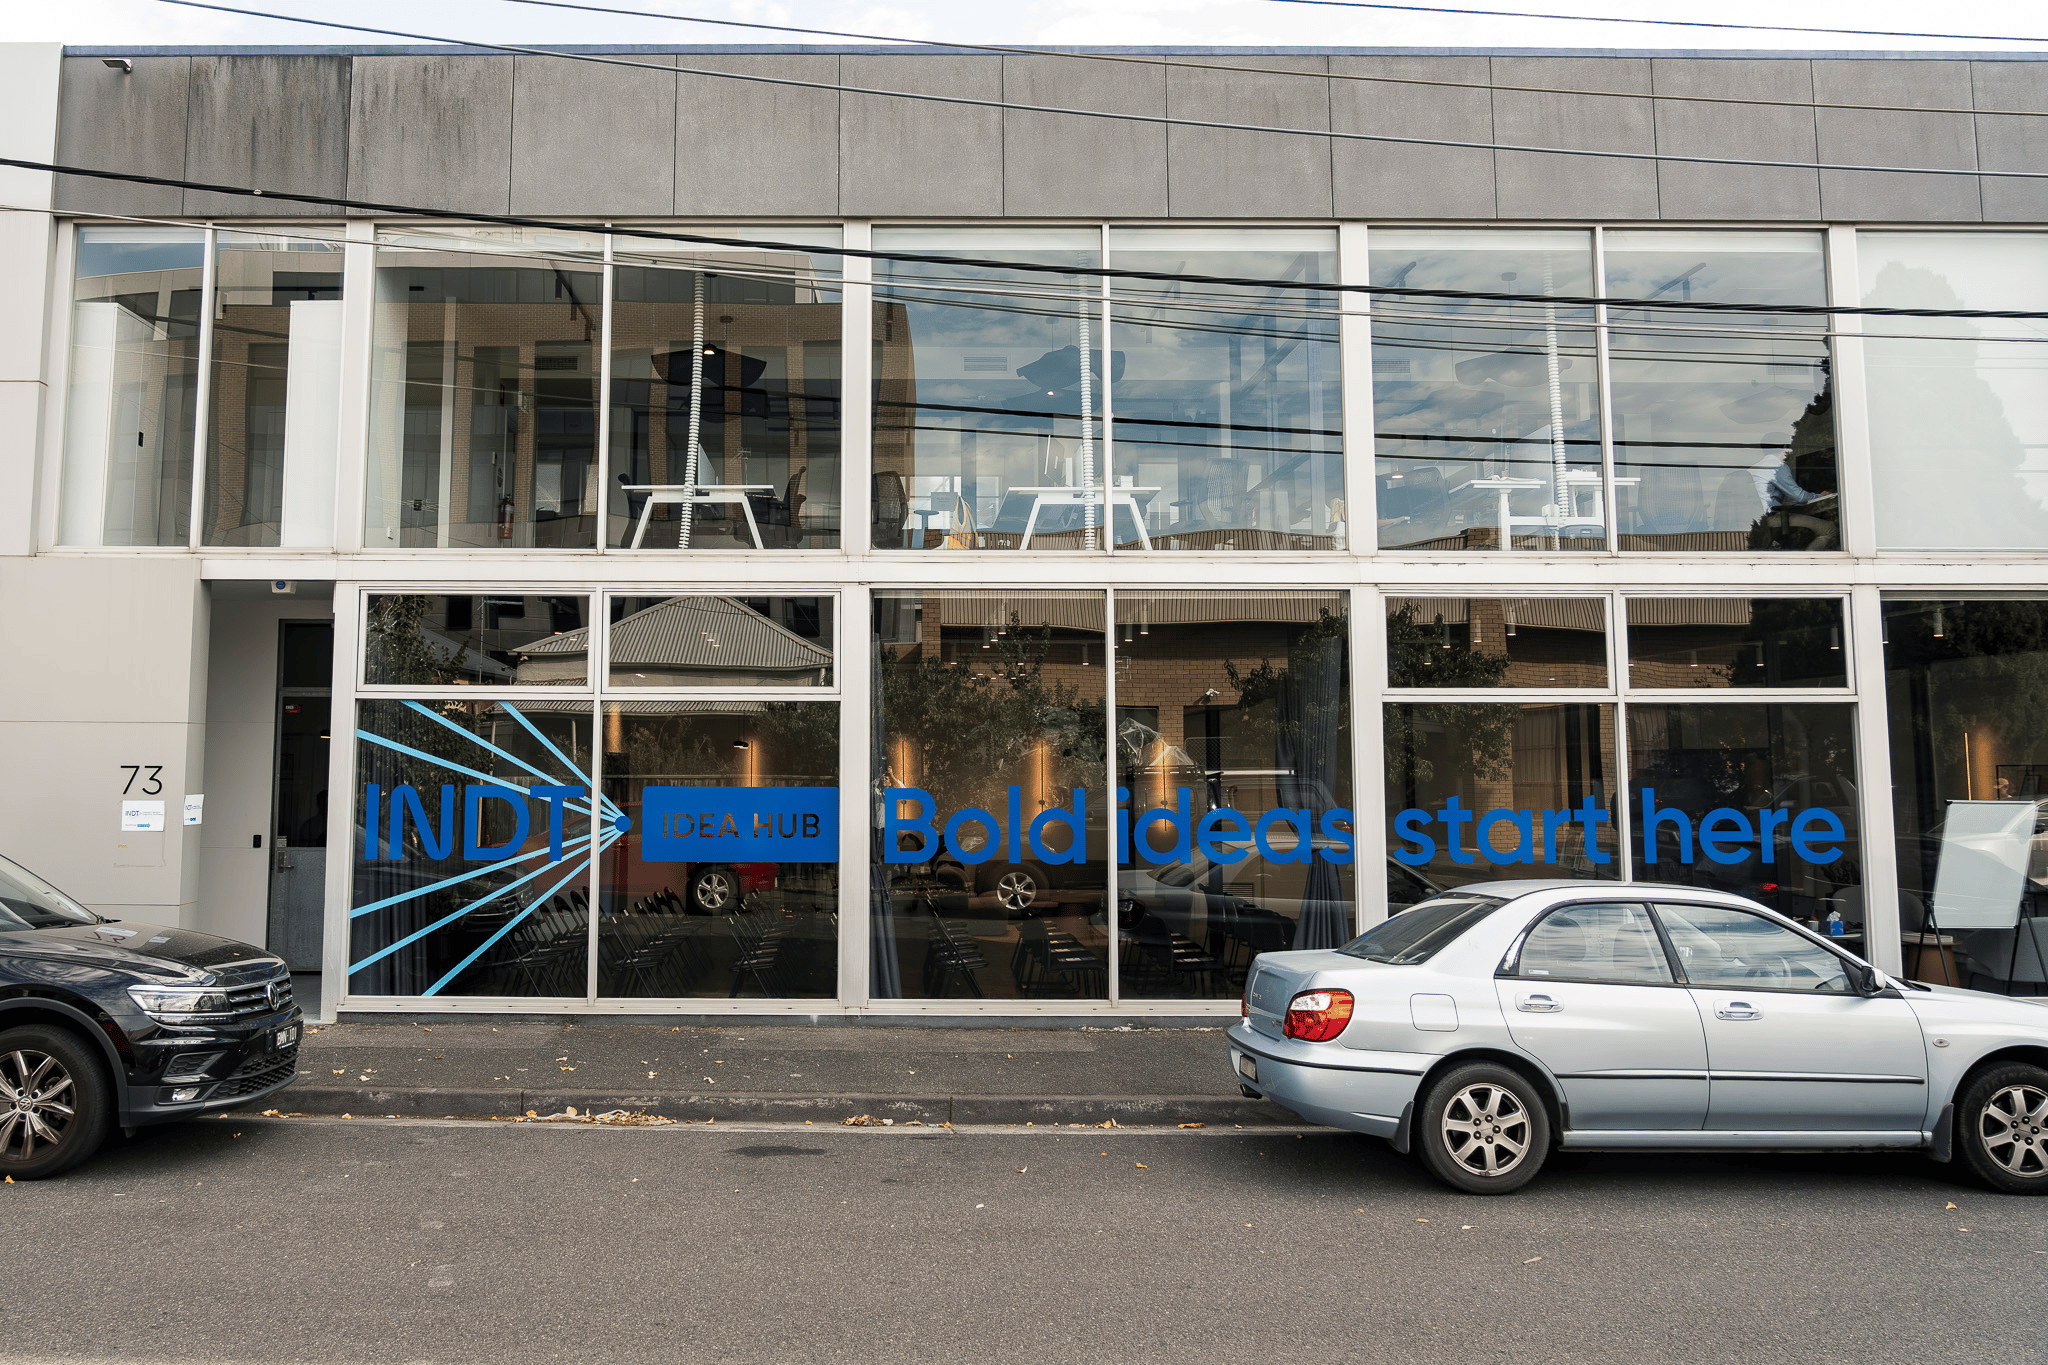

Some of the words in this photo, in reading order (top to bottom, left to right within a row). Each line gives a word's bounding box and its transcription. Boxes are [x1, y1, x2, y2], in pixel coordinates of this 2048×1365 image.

[120, 765, 163, 795] 73
[364, 784, 585, 862] INDT
[663, 812, 740, 838] IDEA
[753, 812, 821, 838] HUB
[884, 784, 1086, 865] Bold
[1116, 786, 1355, 865] ideas
[1393, 795, 1611, 865] start
[1641, 787, 1846, 865] here
